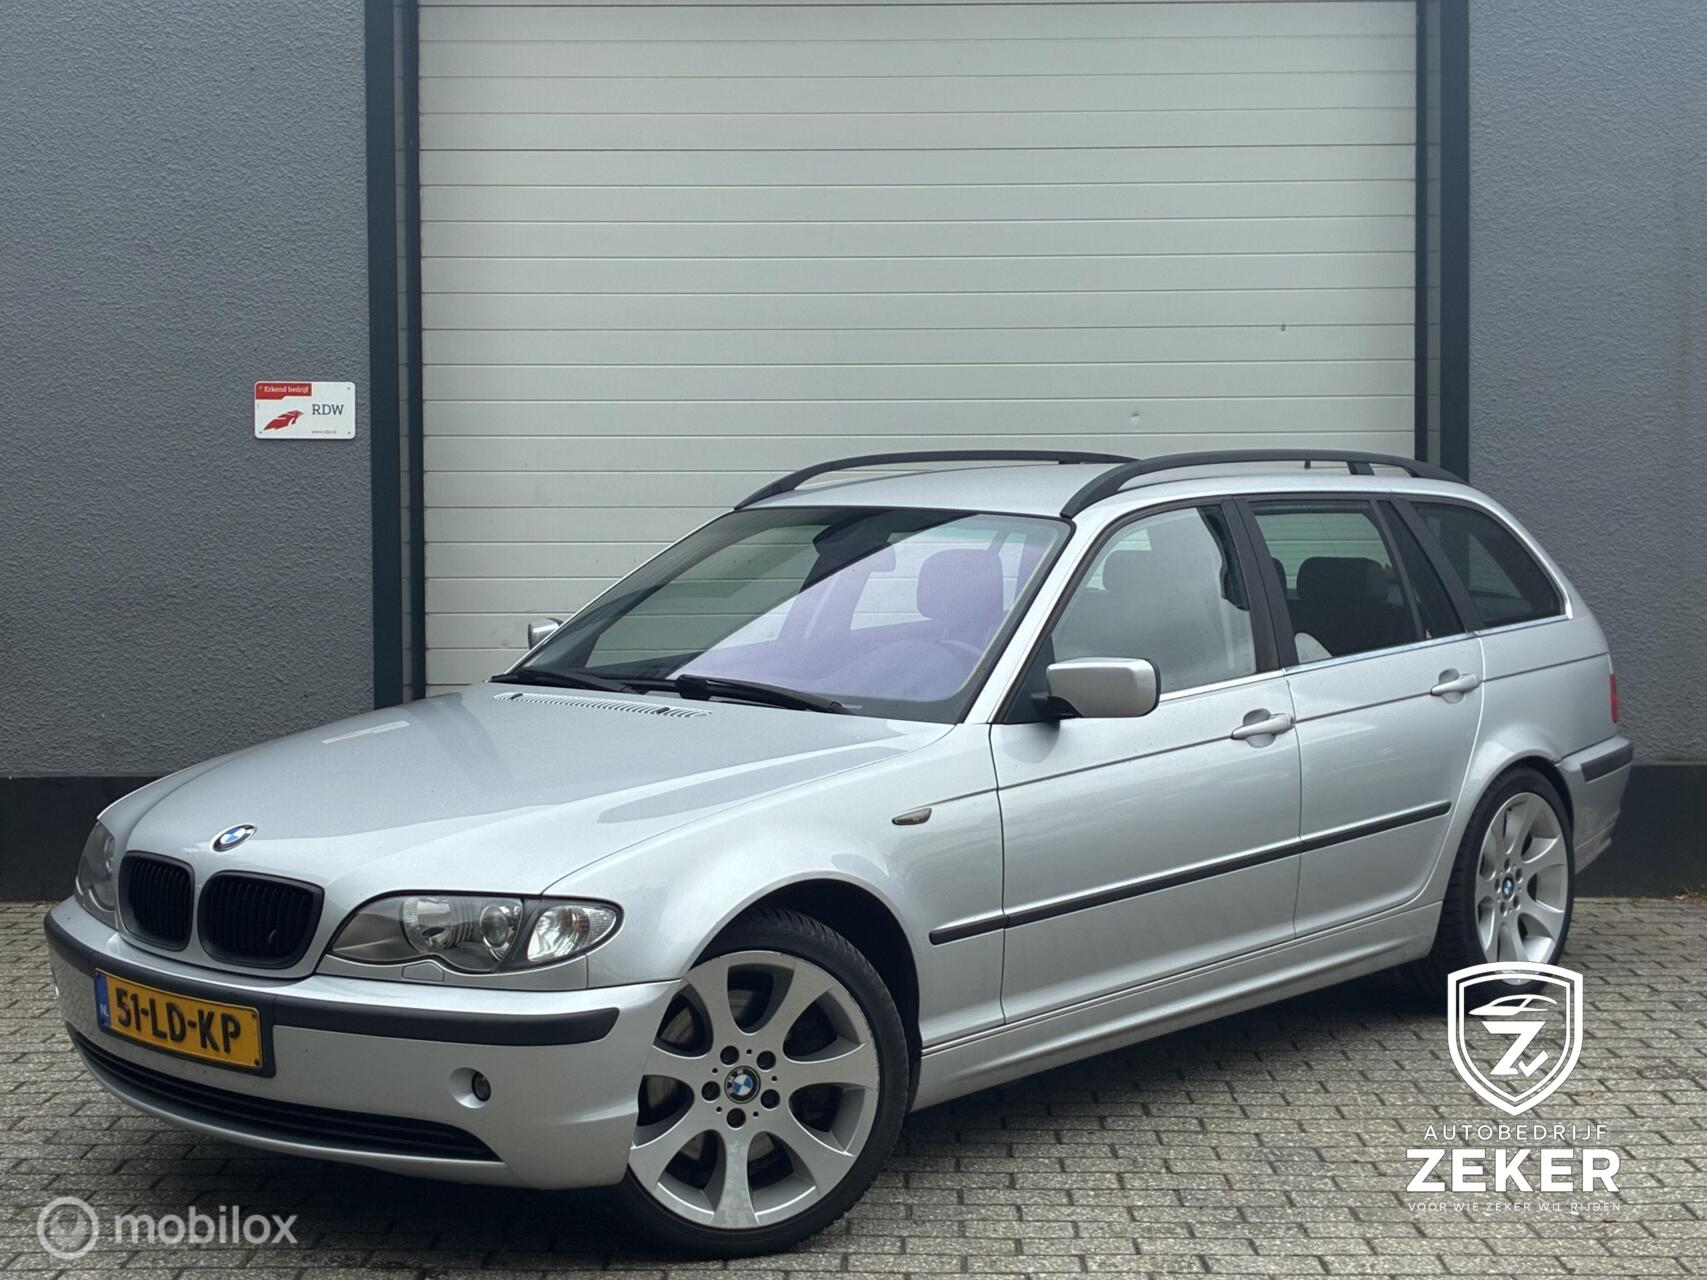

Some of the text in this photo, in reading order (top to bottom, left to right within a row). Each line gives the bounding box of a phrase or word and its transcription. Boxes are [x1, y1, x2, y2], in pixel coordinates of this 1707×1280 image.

[264, 385, 287, 393] Erkend
[312, 404, 344, 415] RDW
[115, 987, 241, 1054] 51-LD-KP
